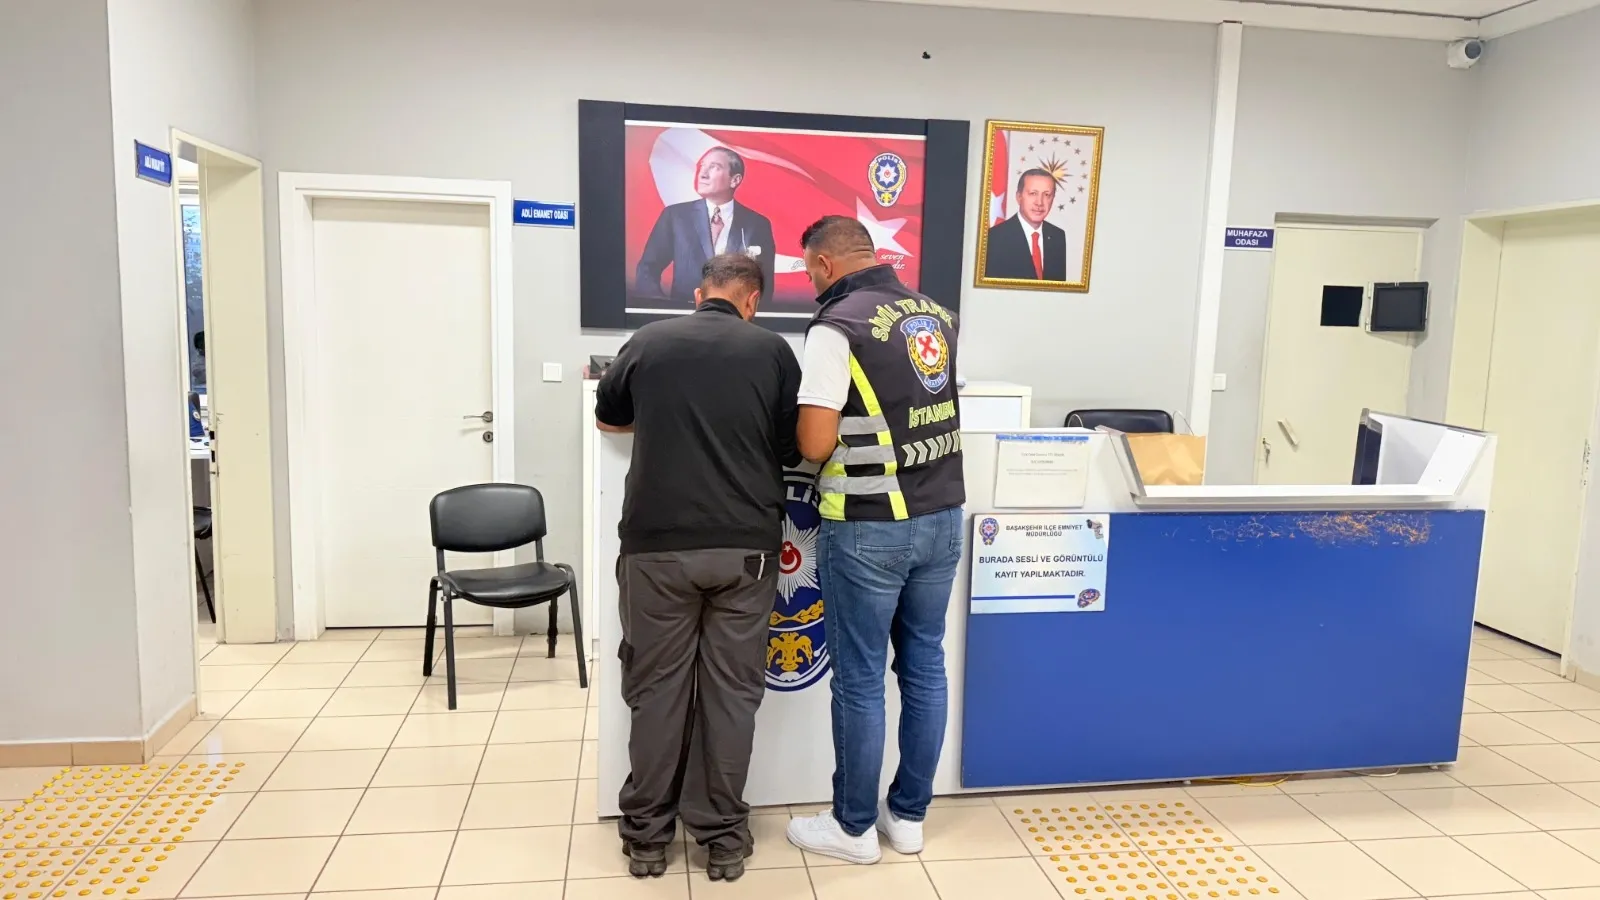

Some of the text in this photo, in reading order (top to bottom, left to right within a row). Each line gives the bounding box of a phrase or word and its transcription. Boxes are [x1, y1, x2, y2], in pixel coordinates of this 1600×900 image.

[521, 206, 568, 220] ADLİ EMANET ODASI
[1005, 524, 1043, 532] BAŞAKŞEHİR
[1043, 524, 1057, 532] İLÇE
[979, 553, 1104, 564] BURADA SESLİ VE GÖRÜNTÜLÜ
[995, 570, 1086, 579] KAYIT YAPILMAKTADIR.
